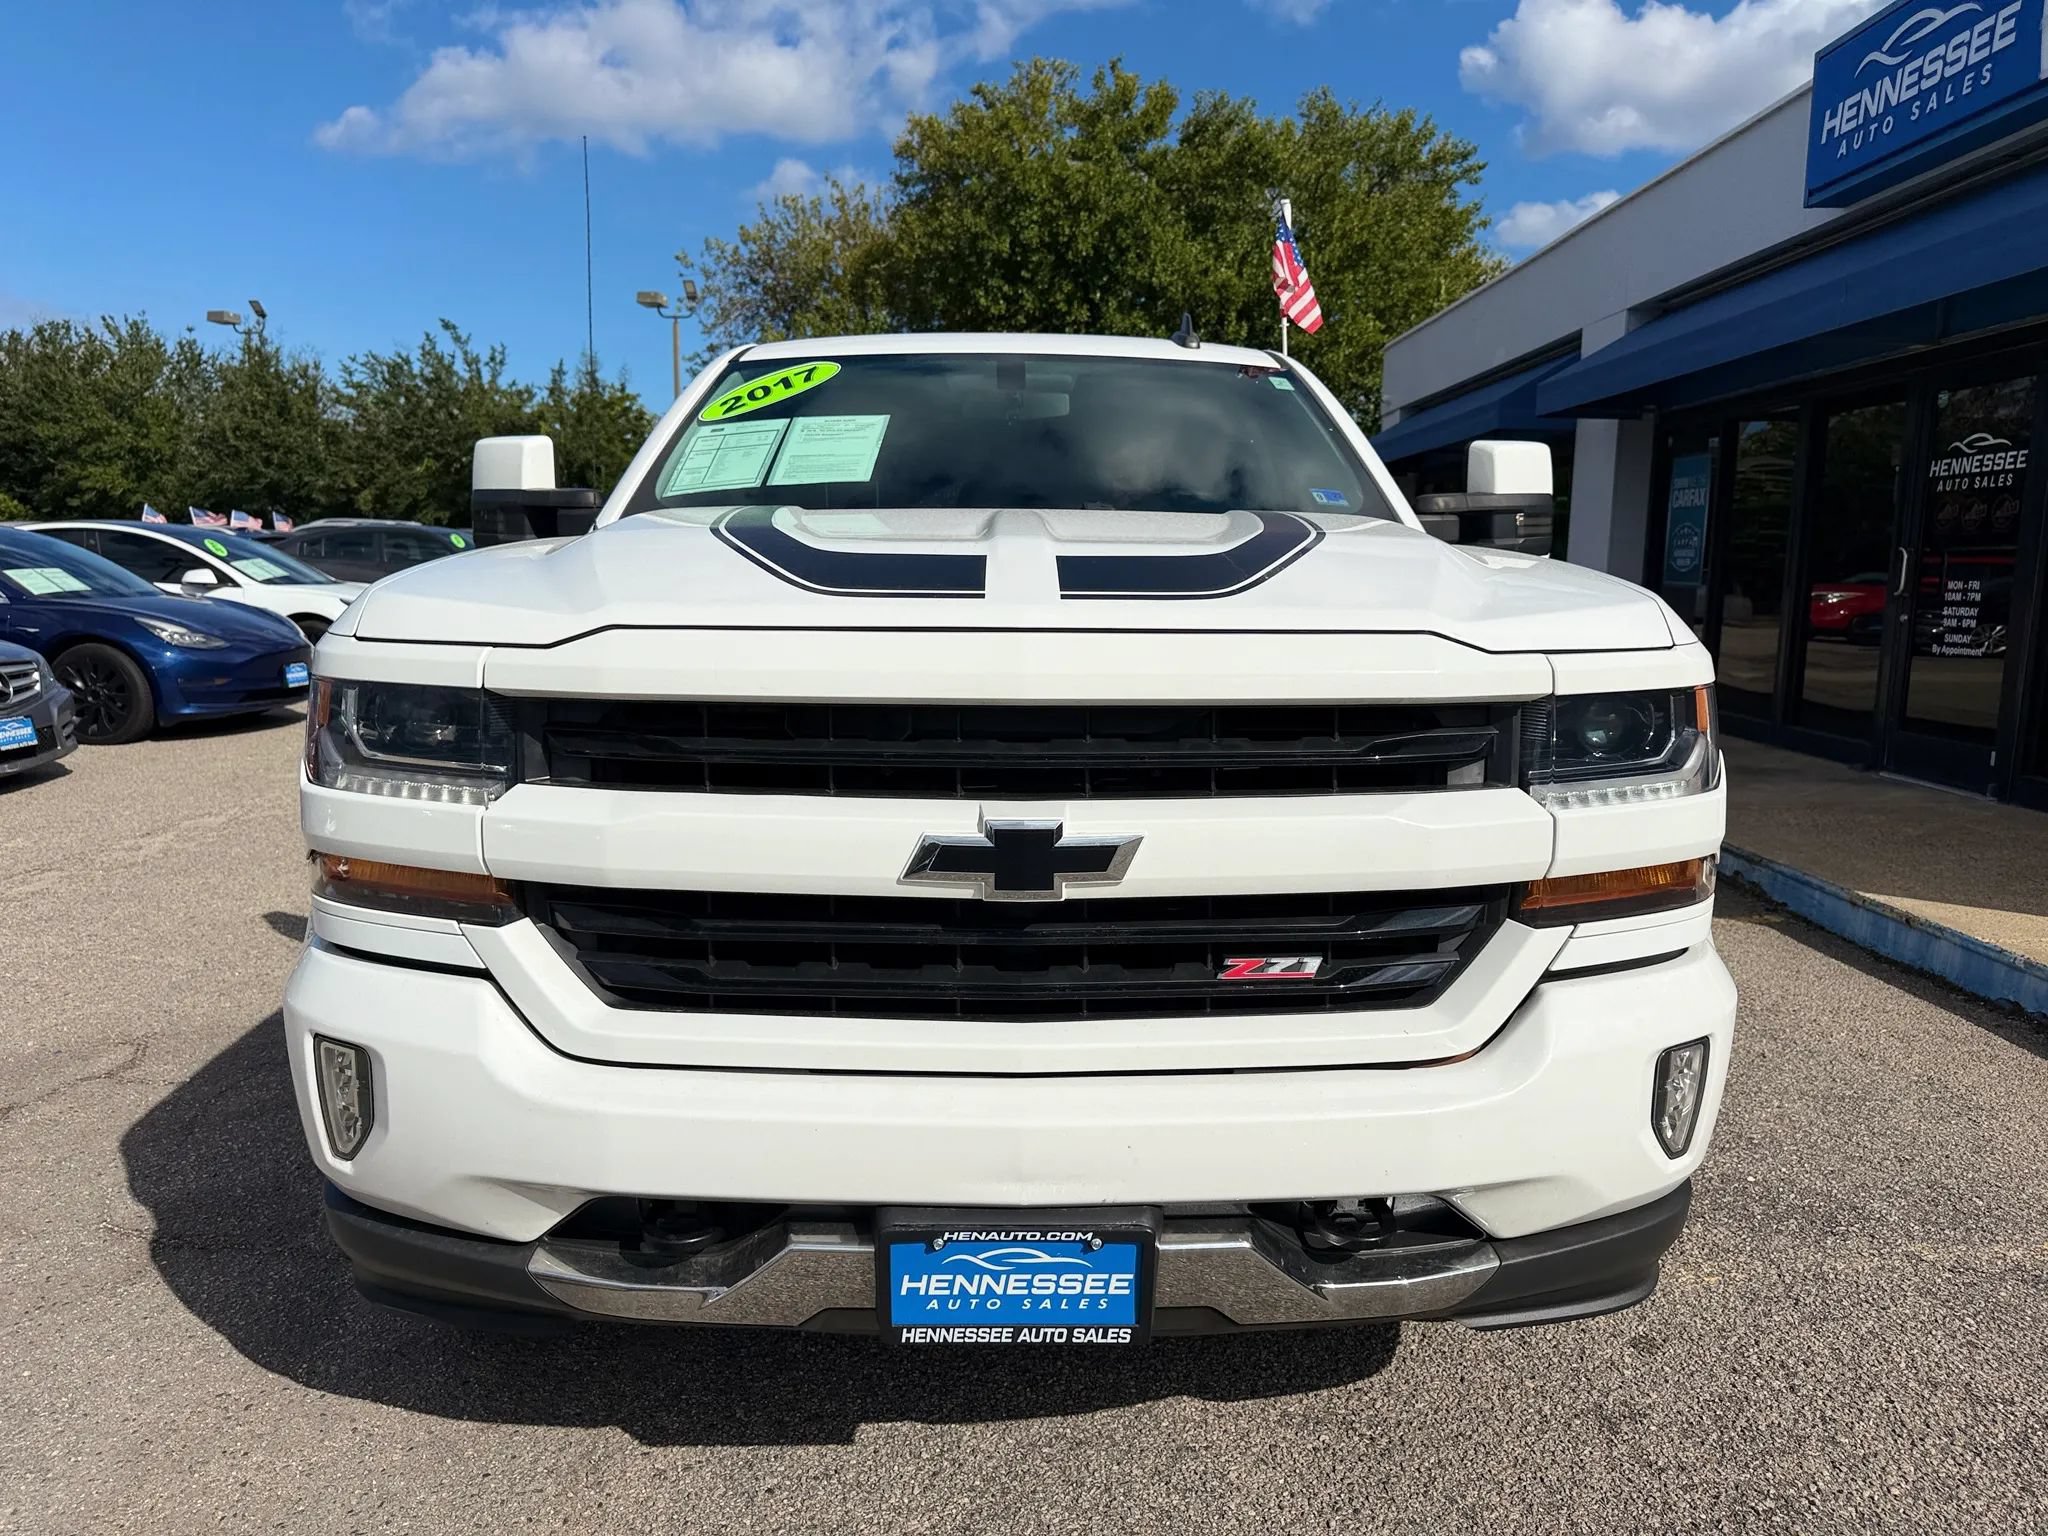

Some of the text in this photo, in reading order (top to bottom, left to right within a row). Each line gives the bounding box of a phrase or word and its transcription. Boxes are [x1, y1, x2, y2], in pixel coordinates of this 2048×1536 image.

[1821, 0, 2021, 144] HENNESSEE
[1837, 63, 1993, 159] AUTO SALES
[719, 366, 818, 416] 2017
[1929, 449, 2028, 477] HENNESSEE
[1937, 473, 2013, 492] AUTO SALES
[1673, 488, 1706, 508] CARFAX
[1947, 581, 1963, 590] MON
[1968, 581, 1980, 590] FRI
[1967, 592, 1981, 601] 7PM
[1943, 607, 1979, 616] SATURDAY
[1944, 634, 1972, 643] SUNDAY
[1932, 644, 1983, 656] By Appointment
[1217, 956, 1323, 979] Z71
[943, 1231, 1093, 1241] HENAUTO.COM
[900, 1274, 1134, 1296] HENNESSEE
[926, 1298, 1108, 1310] AUTO SALES
[901, 1328, 1131, 1343] HENNESSEE AUTO SALES
